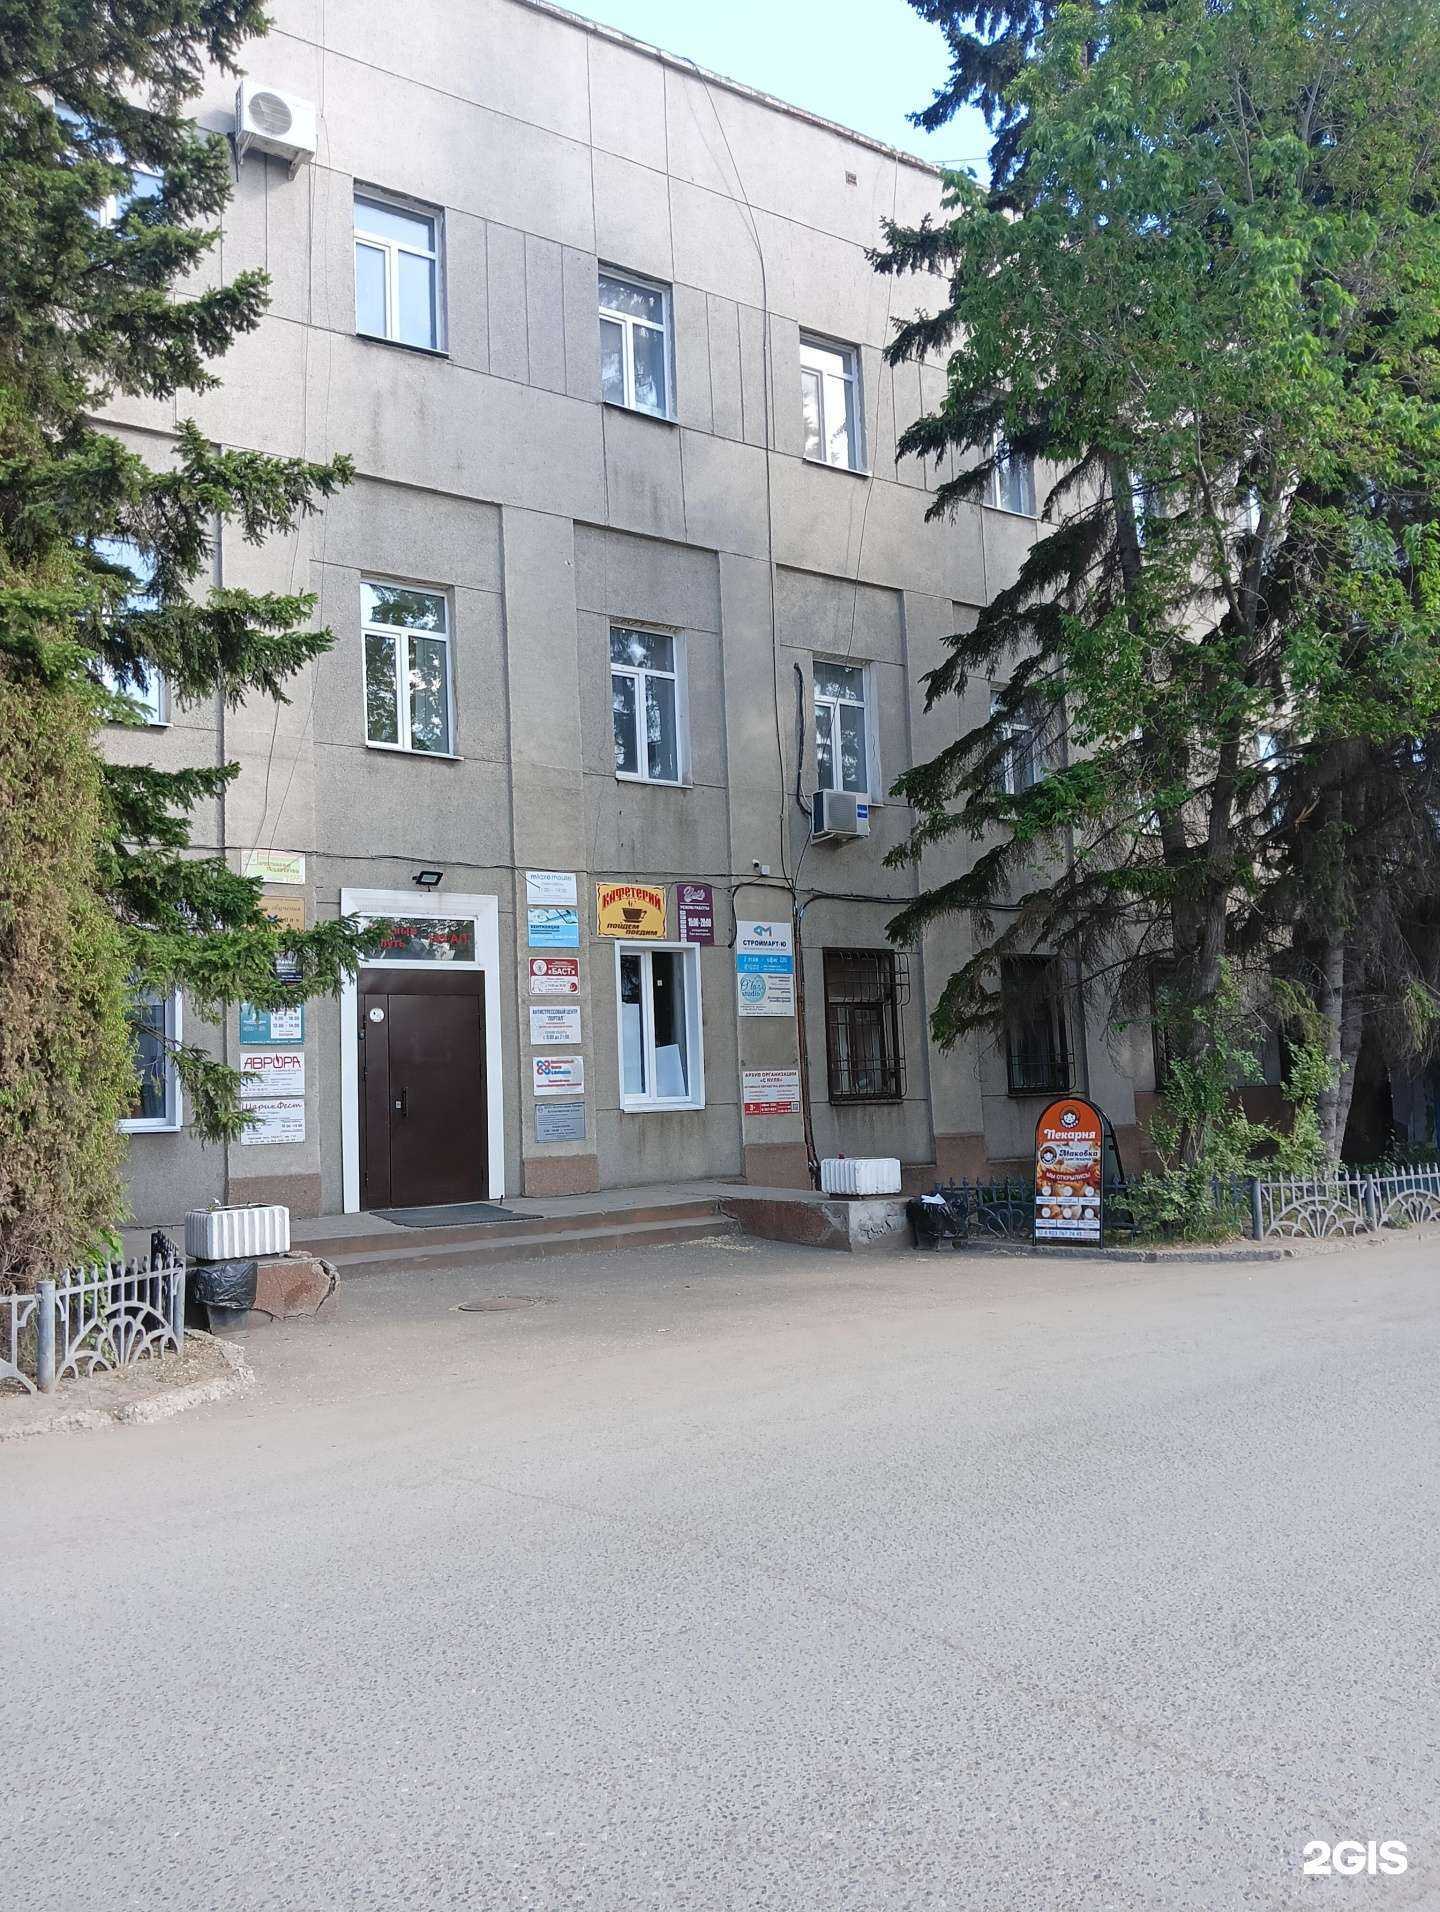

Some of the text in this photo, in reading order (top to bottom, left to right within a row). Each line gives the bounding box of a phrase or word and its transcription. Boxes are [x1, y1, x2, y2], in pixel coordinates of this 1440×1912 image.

[244, 1054, 302, 1069] АВРОРА
[1044, 1129, 1096, 1141] Пекарня
[1059, 1149, 1098, 1157] Маковка
